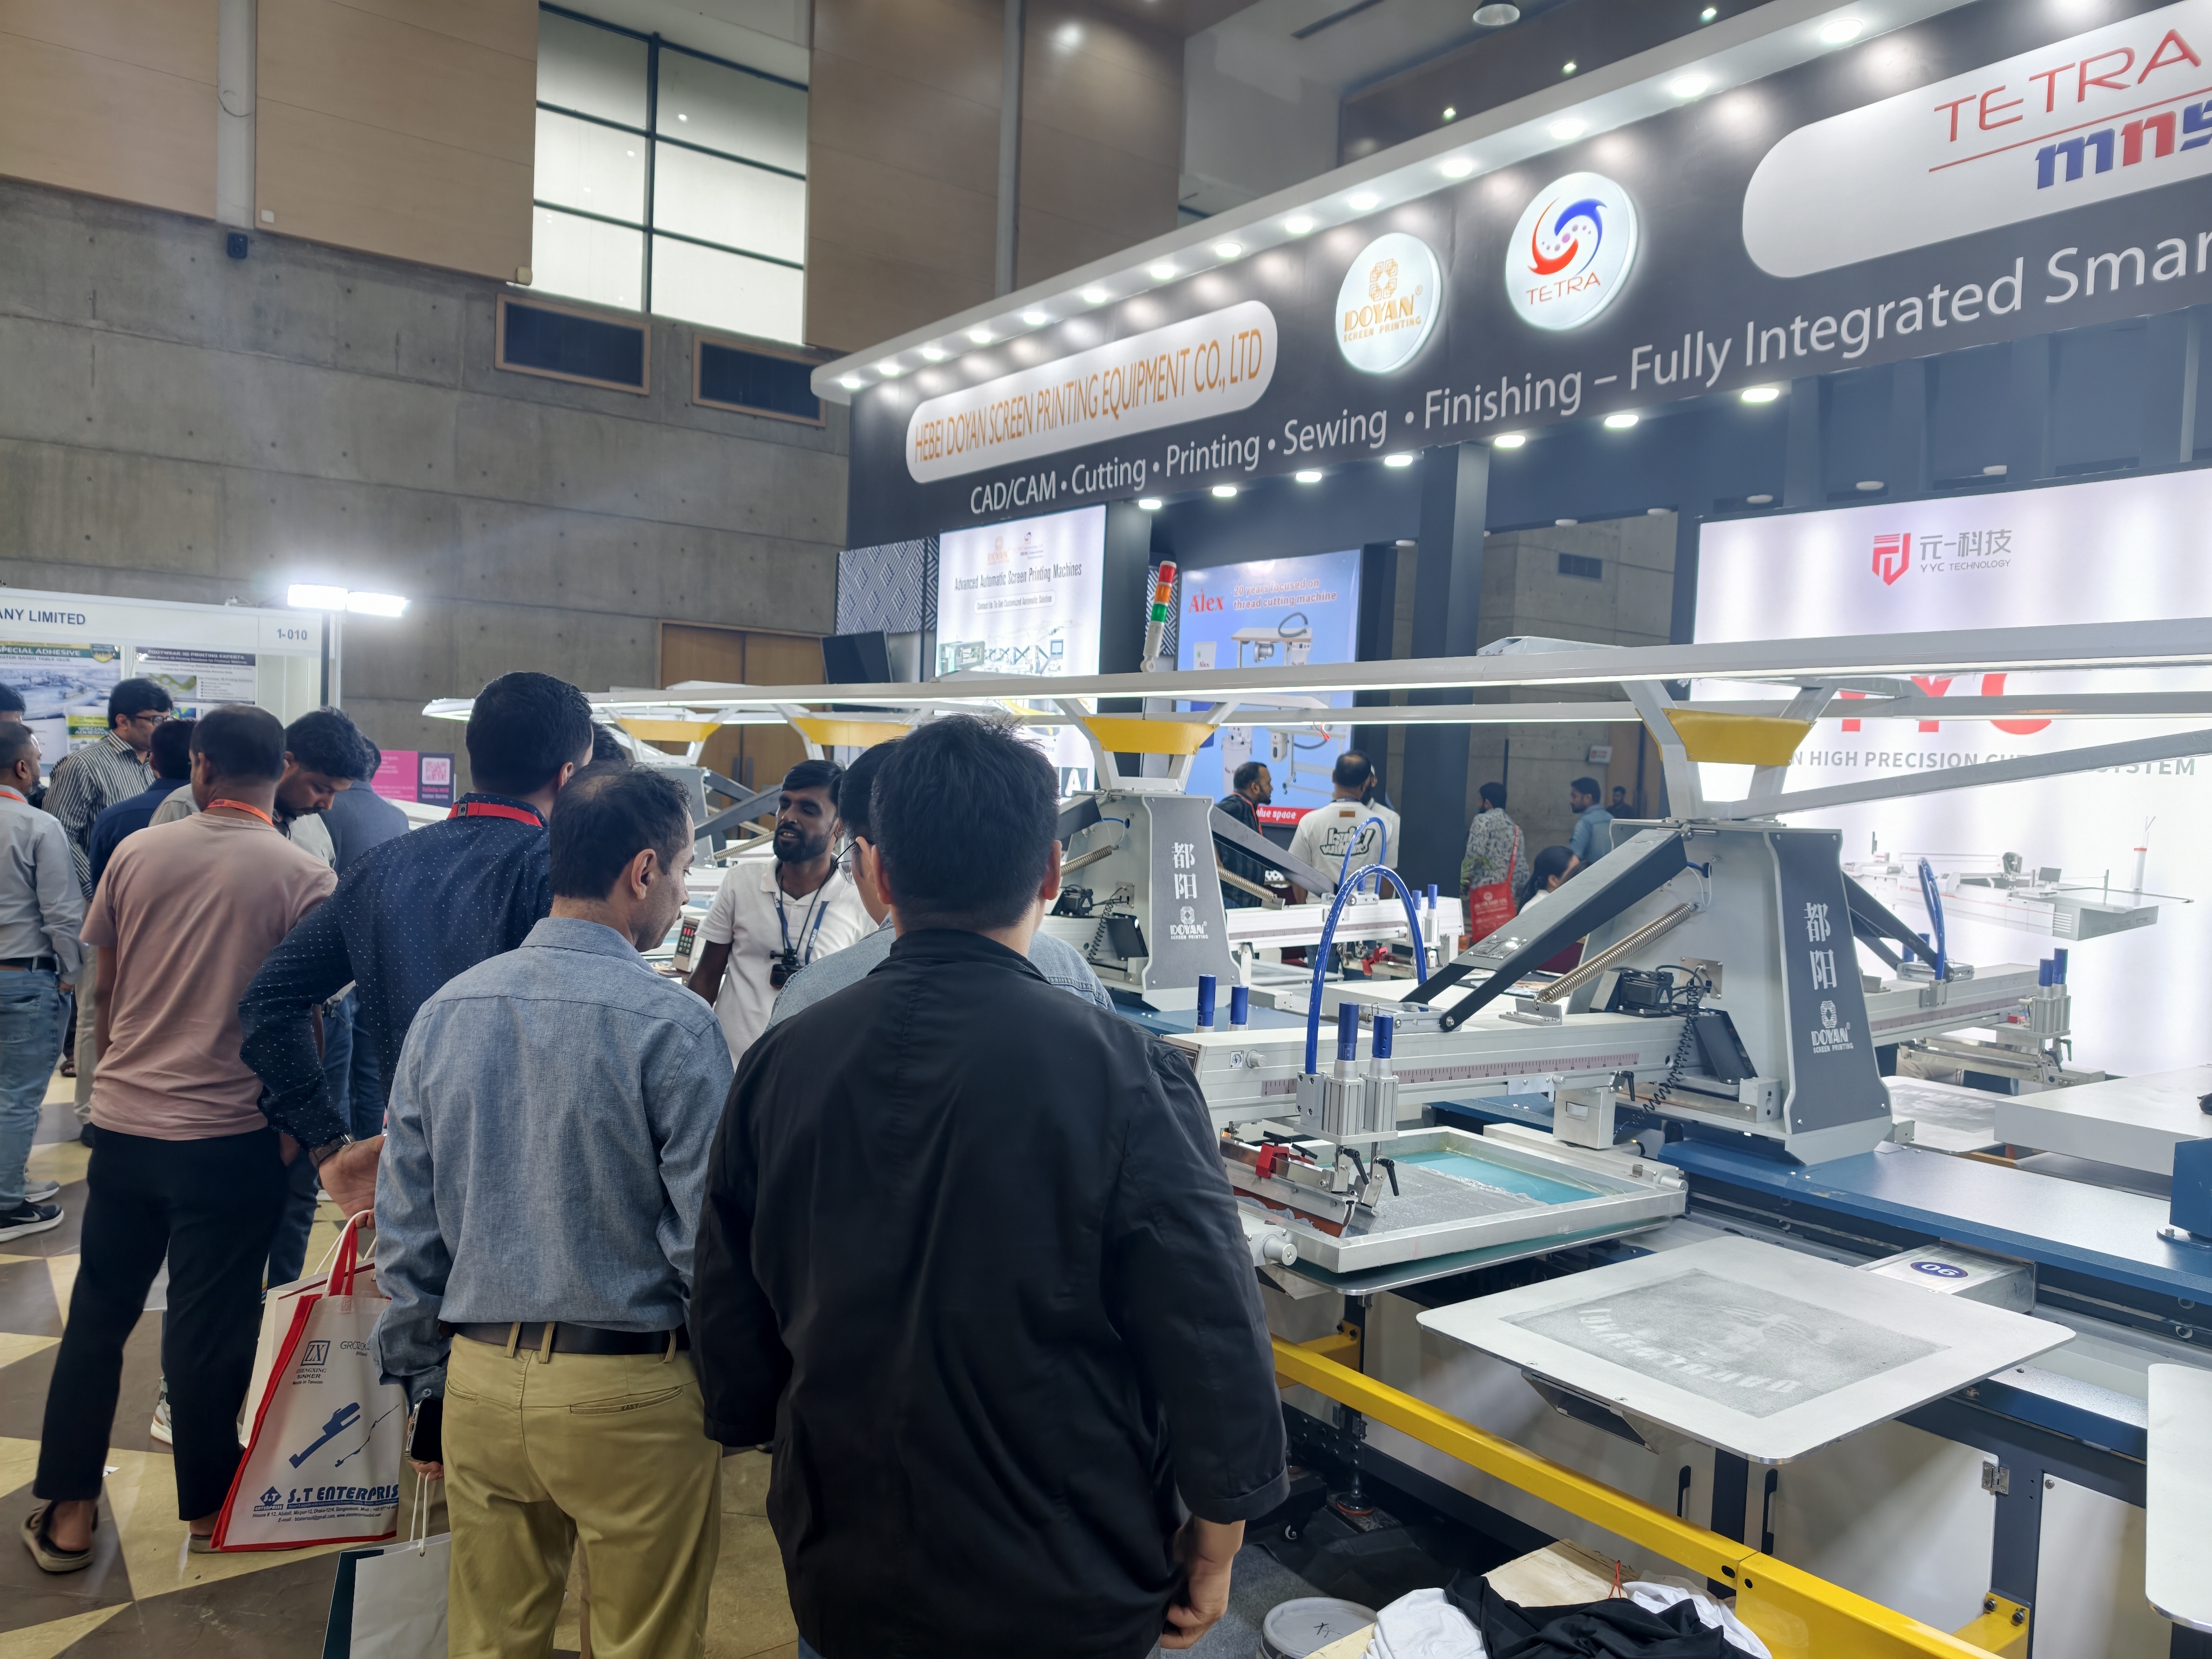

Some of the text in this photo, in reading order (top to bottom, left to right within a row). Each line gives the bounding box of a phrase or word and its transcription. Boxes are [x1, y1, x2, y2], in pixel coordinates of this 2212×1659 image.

[1934, 28, 2202, 143] TETRA
[1526, 272, 1601, 305] TETRA
[1344, 294, 1414, 332] DOYAN
[1344, 315, 1421, 342] SCREEN PRINTING
[970, 470, 1056, 514] CAD/CAM
[1072, 457, 1146, 496] Cutting
[1166, 433, 1260, 477] Printing
[1283, 408, 1387, 456] Sewing
[1425, 369, 1582, 429] Finishing
[1630, 331, 1732, 390] Fully
[1746, 257, 2024, 366] Integrated
[2045, 231, 2212, 304] Smar
[914, 419, 942, 463] HEBEI
[947, 406, 987, 455] DOYAN
[989, 393, 1033, 443] SCREEN
[1036, 374, 1098, 431] PRINTING
[1103, 347, 1190, 420] EQUIPMENT
[1230, 328, 1262, 383] LTD
[1919, 529, 2012, 561] 元一科技
[1948, 559, 2012, 571] TECHNOLOGY
[954, 561, 1082, 591] Advanced Automatic Screen Printing Machines
[1233, 578, 1320, 598] 20 years focused on
[1189, 588, 1224, 613] Alex
[1233, 590, 1337, 611] thread cutting machine
[29, 610, 86, 625] LIMITED
[276, 628, 308, 640] 1-010
[0, 646, 80, 657] SPECIAL ADHESIVE
[147, 649, 180, 657] FOOTWEAR
[1198, 660, 1210, 668] Alex
[1809, 751, 1858, 767] HIGH
[1864, 751, 1978, 768] PRECISION
[2094, 757, 2196, 775] STEM
[1272, 810, 1297, 821] space
[1171, 842, 1197, 900] 都阳
[1170, 923, 1204, 935] DOYAN
[1803, 902, 1837, 990] 都阳
[1811, 1027, 1849, 1047] DOYAN
[1813, 1042, 1854, 1054] SCREEN PRINTING
[1921, 1264, 1959, 1276] 06
[304, 1344, 326, 1362] ZX
[263, 1493, 278, 1501] S.T
[287, 1487, 314, 1503] S.T
